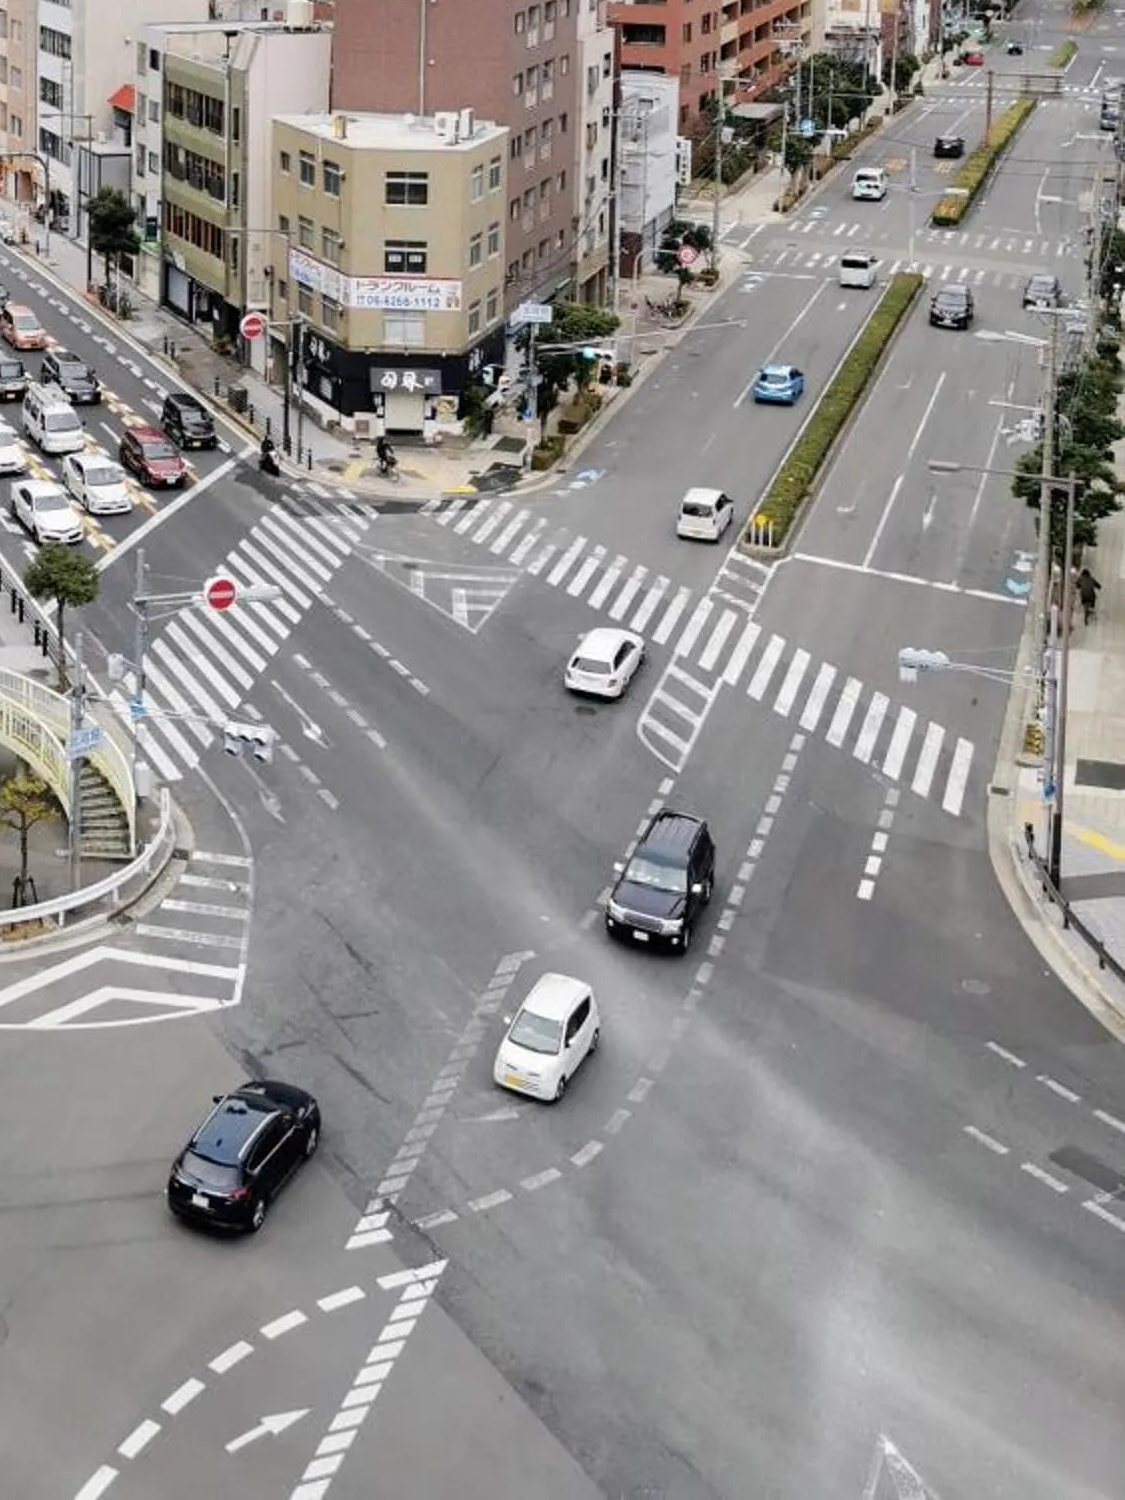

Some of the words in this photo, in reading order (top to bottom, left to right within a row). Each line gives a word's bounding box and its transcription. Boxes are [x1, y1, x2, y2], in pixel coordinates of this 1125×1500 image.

[356, 280, 441, 295] トランクルーム
